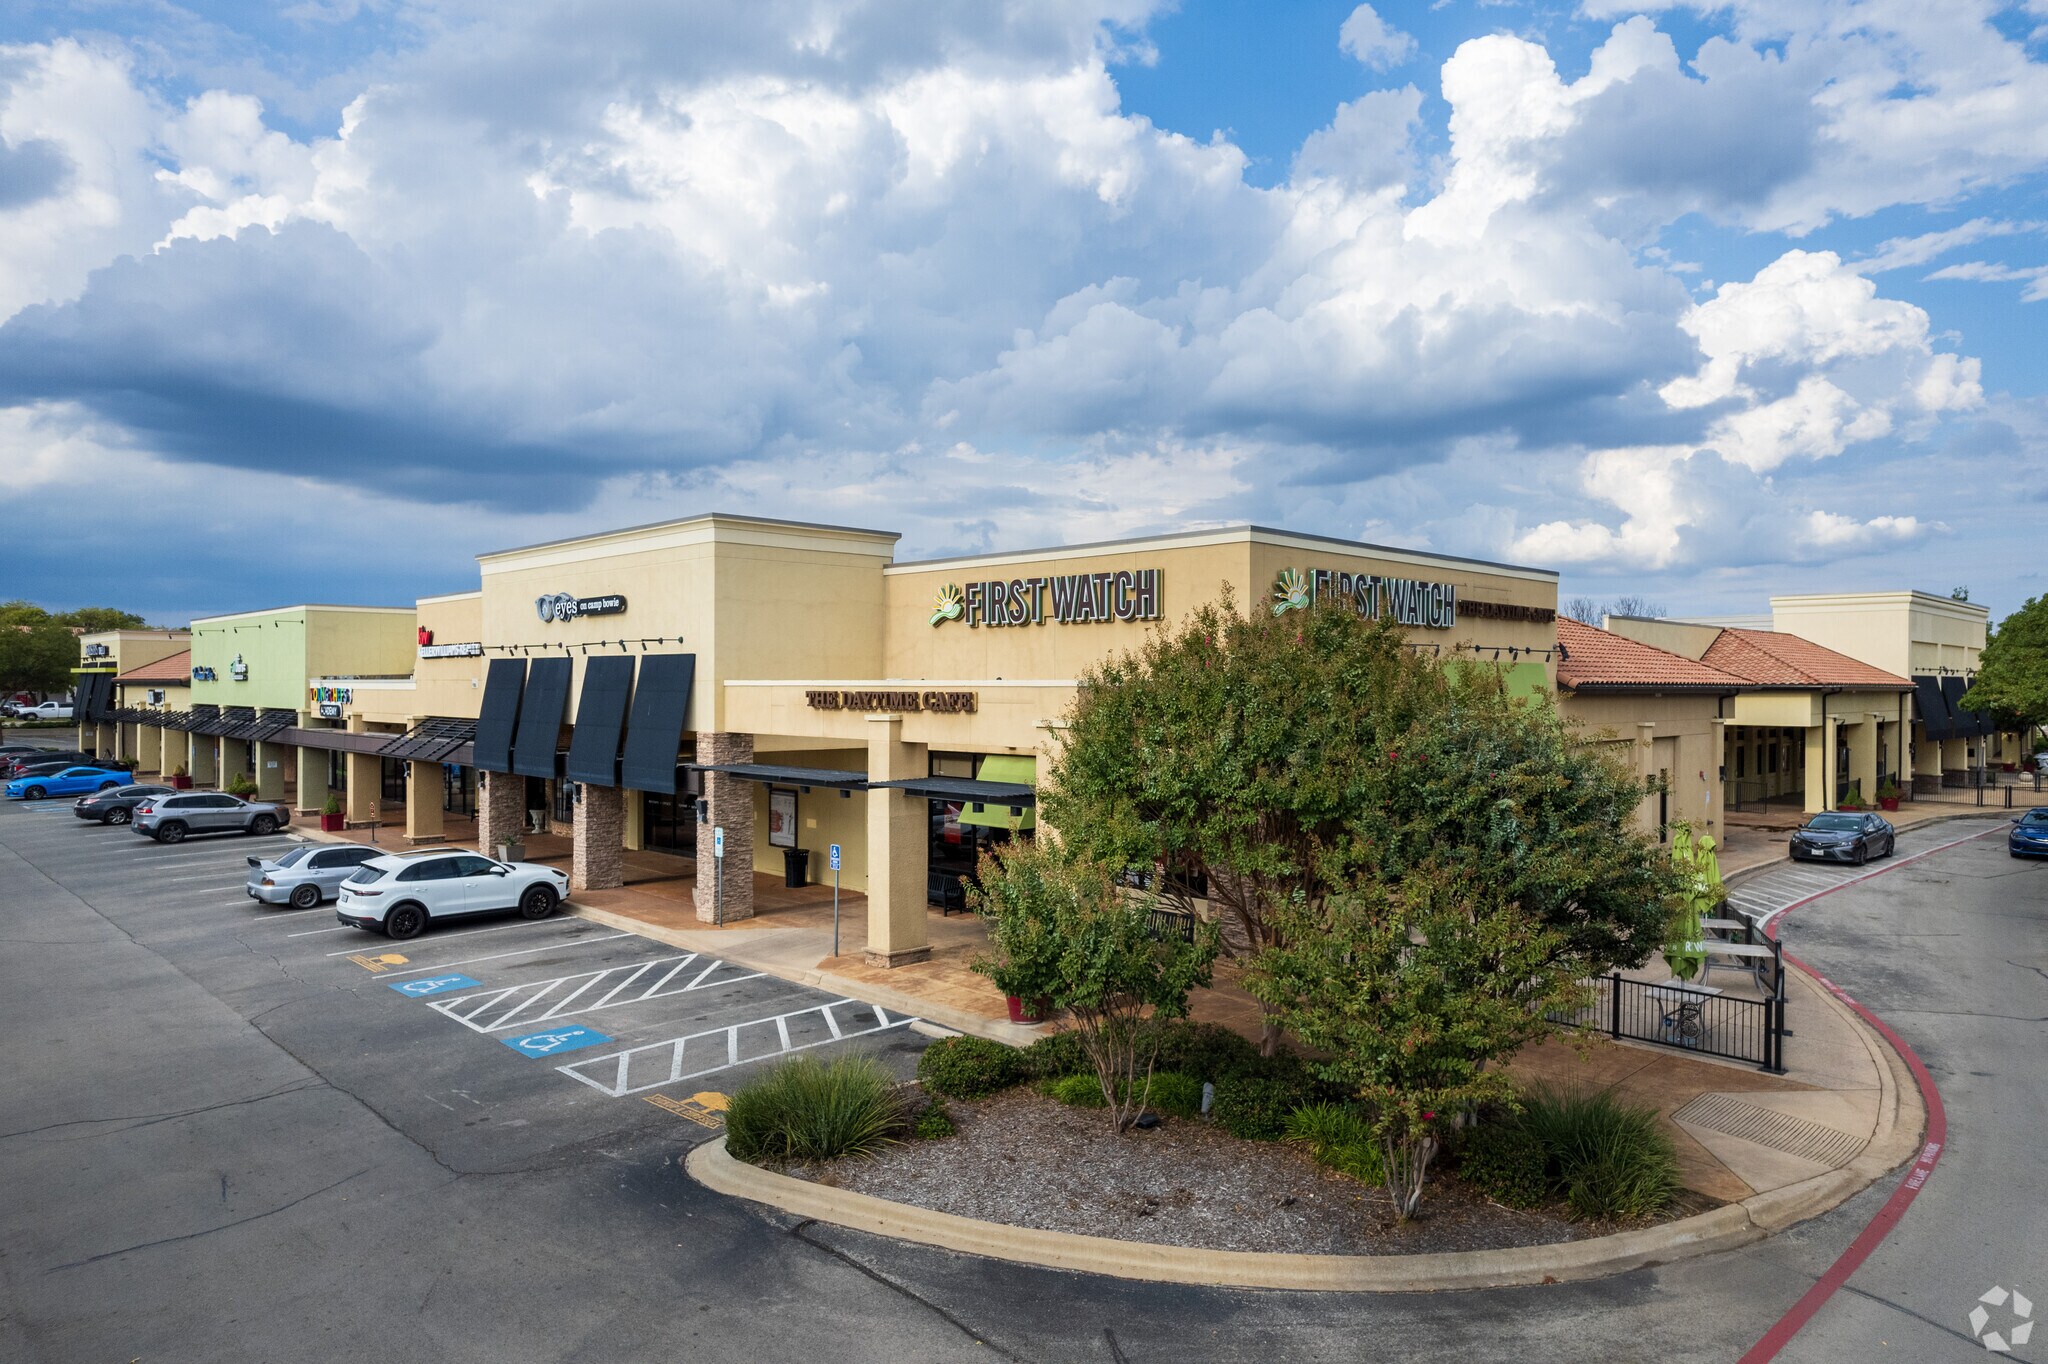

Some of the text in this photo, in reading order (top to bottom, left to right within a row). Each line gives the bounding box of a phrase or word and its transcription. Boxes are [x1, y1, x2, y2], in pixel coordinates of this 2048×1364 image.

[555, 600, 578, 618] eyes
[965, 568, 1162, 627] FIRST WATCH
[1312, 568, 1456, 628] FIRST WATCH
[805, 690, 977, 713] THE DAYTIME CAFE
